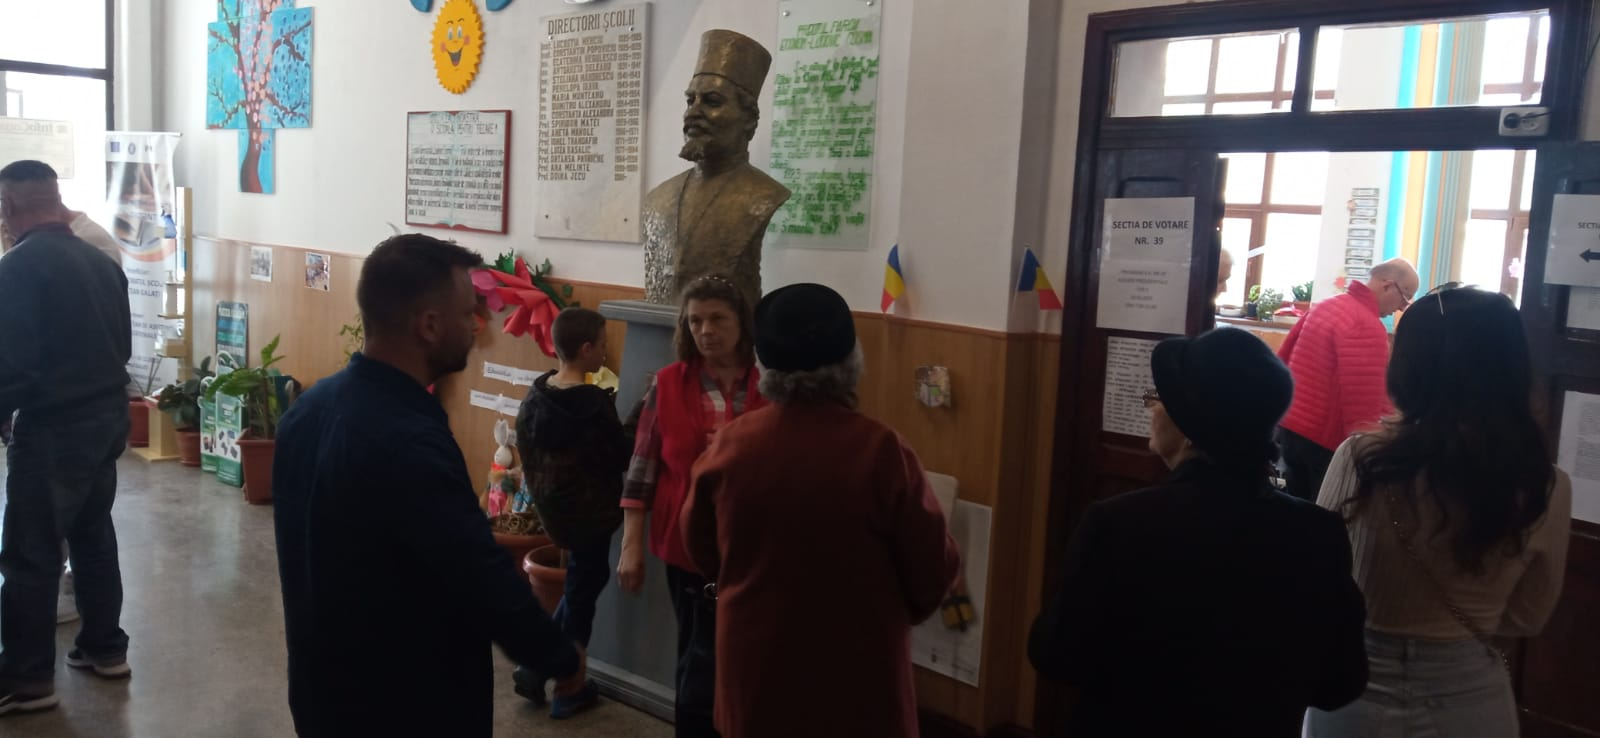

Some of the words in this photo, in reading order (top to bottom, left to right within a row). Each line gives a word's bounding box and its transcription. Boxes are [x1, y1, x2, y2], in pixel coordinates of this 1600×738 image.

[548, 13, 600, 35] DIRECTORII
[552, 94, 569, 102] MARIA
[572, 91, 604, 100] MUNTEANU
[578, 100, 611, 109] ALEXANDRU
[582, 109, 614, 118] ALEXANDRU
[581, 119, 600, 127] MATEI
[571, 128, 594, 136] MANOLE
[565, 164, 590, 172] MELINTE
[1112, 221, 1139, 230] SECTIA
[1142, 221, 1153, 229] DE
[1156, 220, 1189, 229] VOTARE
[1134, 237, 1149, 245] NR.
[1153, 237, 1164, 245] 39
